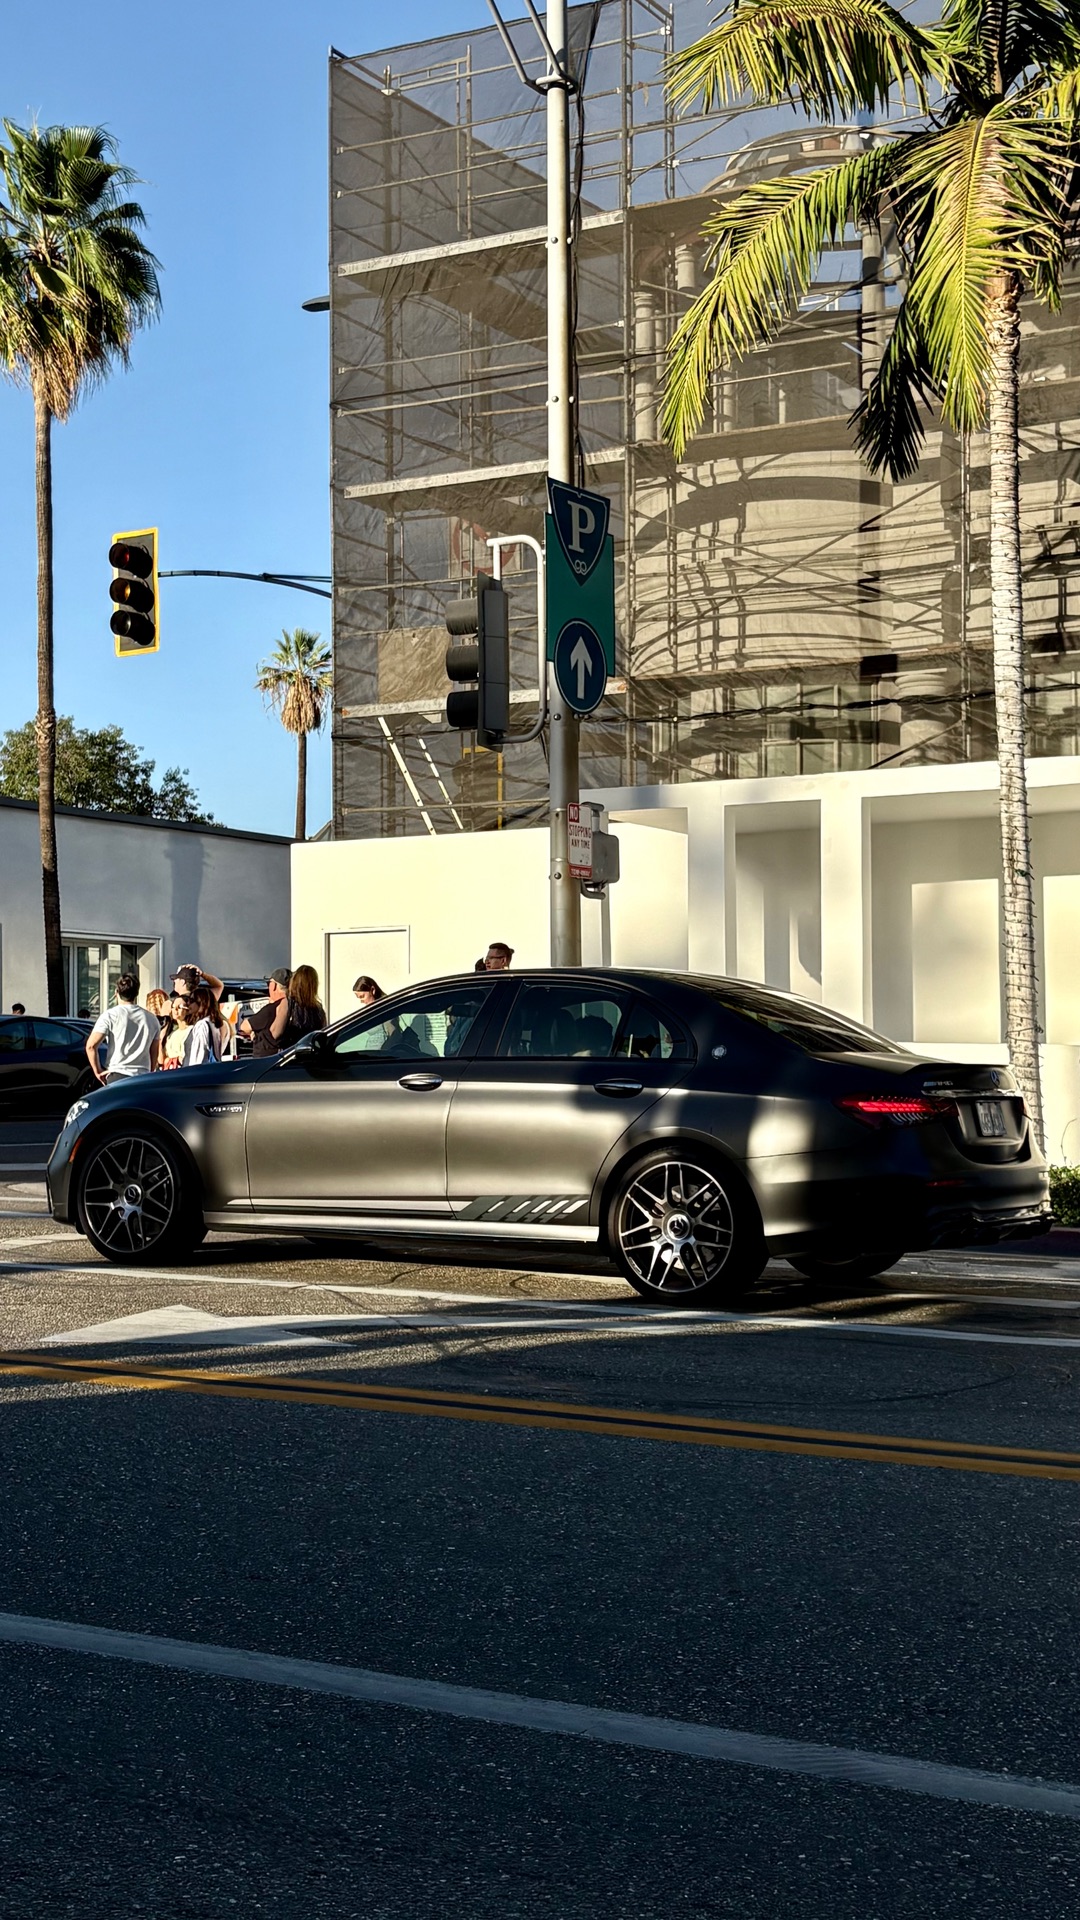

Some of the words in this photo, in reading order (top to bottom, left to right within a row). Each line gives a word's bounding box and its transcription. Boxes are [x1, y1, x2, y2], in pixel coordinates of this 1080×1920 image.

[567, 500, 596, 554] P
[569, 806, 579, 821] NO
[569, 825, 592, 839] STOPPING
[571, 839, 580, 848] ANY
[581, 840, 590, 849] TIME
